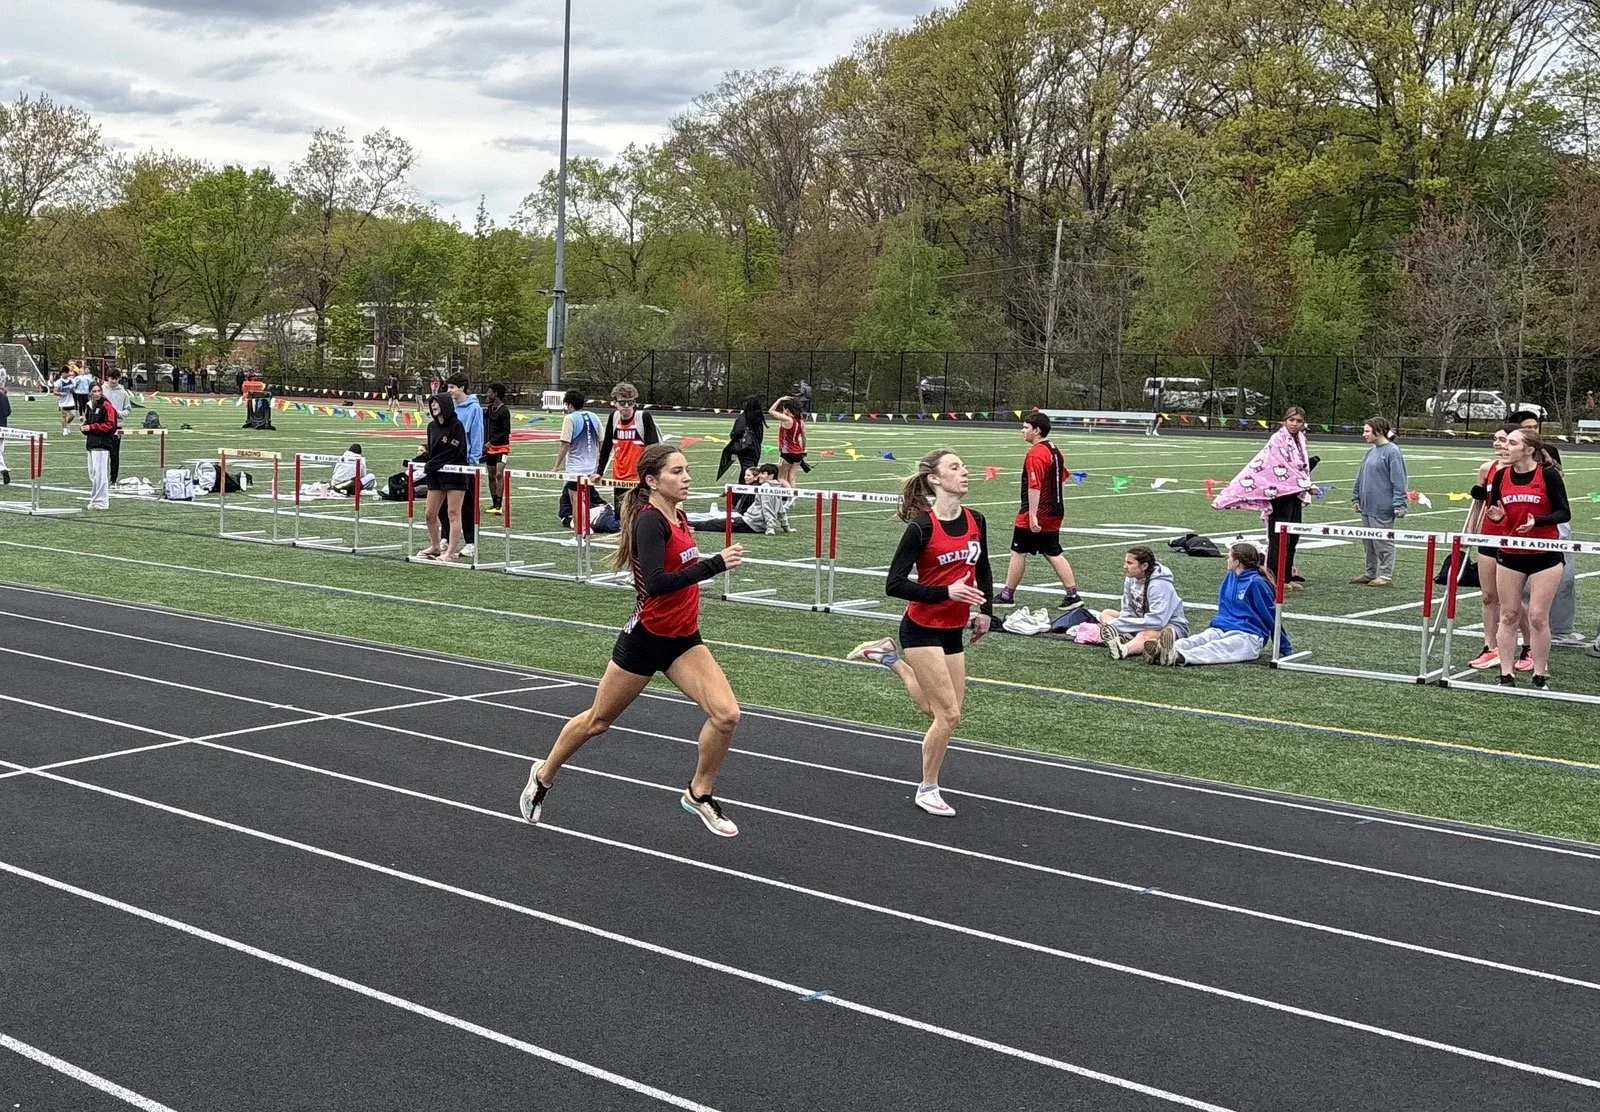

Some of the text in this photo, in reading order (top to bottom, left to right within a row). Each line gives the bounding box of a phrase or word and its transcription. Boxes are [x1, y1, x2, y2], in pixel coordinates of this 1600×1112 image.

[1333, 528, 1383, 538] READING
[1512, 539, 1568, 551] READING
[969, 542, 979, 564] 2
